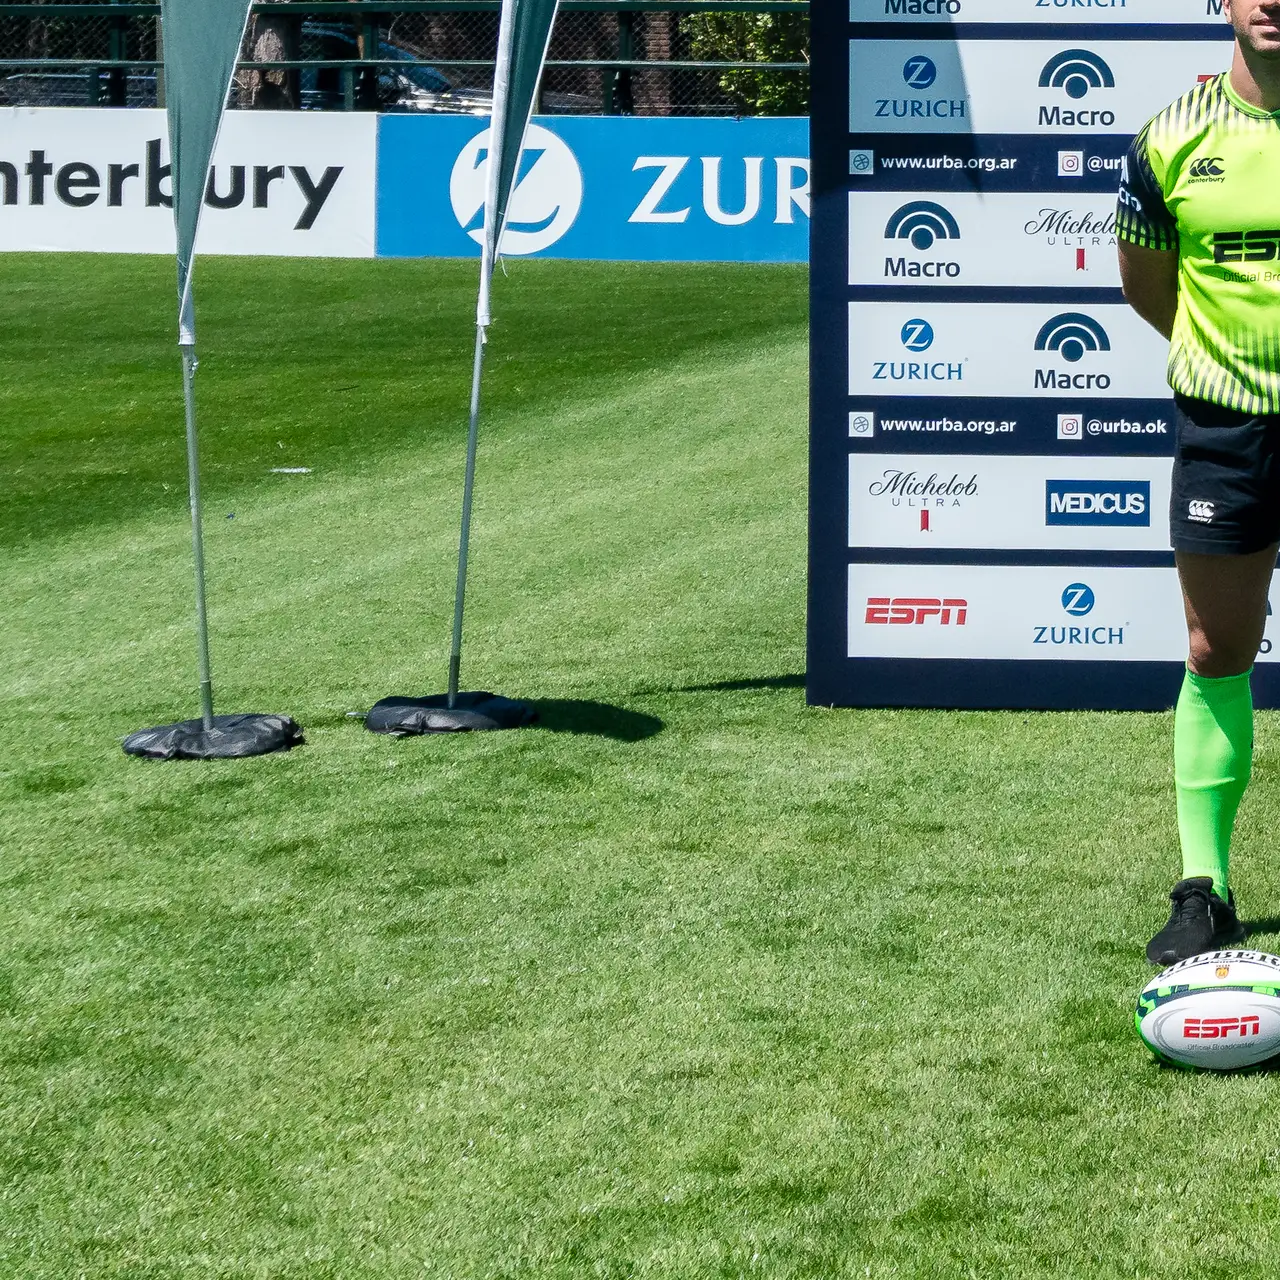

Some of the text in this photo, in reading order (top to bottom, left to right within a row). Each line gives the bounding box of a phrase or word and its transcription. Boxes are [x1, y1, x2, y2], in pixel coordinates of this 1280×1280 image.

[874, 98, 966, 118] ZURICH
[1037, 105, 1116, 127] Macro
[881, 153, 1018, 174] www.urba.org.ar
[1187, 176, 1226, 184] canterbury
[1047, 236, 1117, 246] ULTRA
[883, 256, 961, 278] Macro
[1223, 270, 1261, 283] Official
[872, 361, 964, 381] ZURICH
[1034, 368, 1111, 391] Macro
[880, 417, 1017, 437] www.urba.org.ar
[1087, 417, 1167, 437] @urba.ok
[891, 498, 961, 507] ULTRA
[1050, 492, 1145, 514] MEDICUS
[864, 596, 968, 625] ESPN
[1033, 626, 1125, 645] ZURICH
[1183, 1015, 1260, 1039] ESPN
